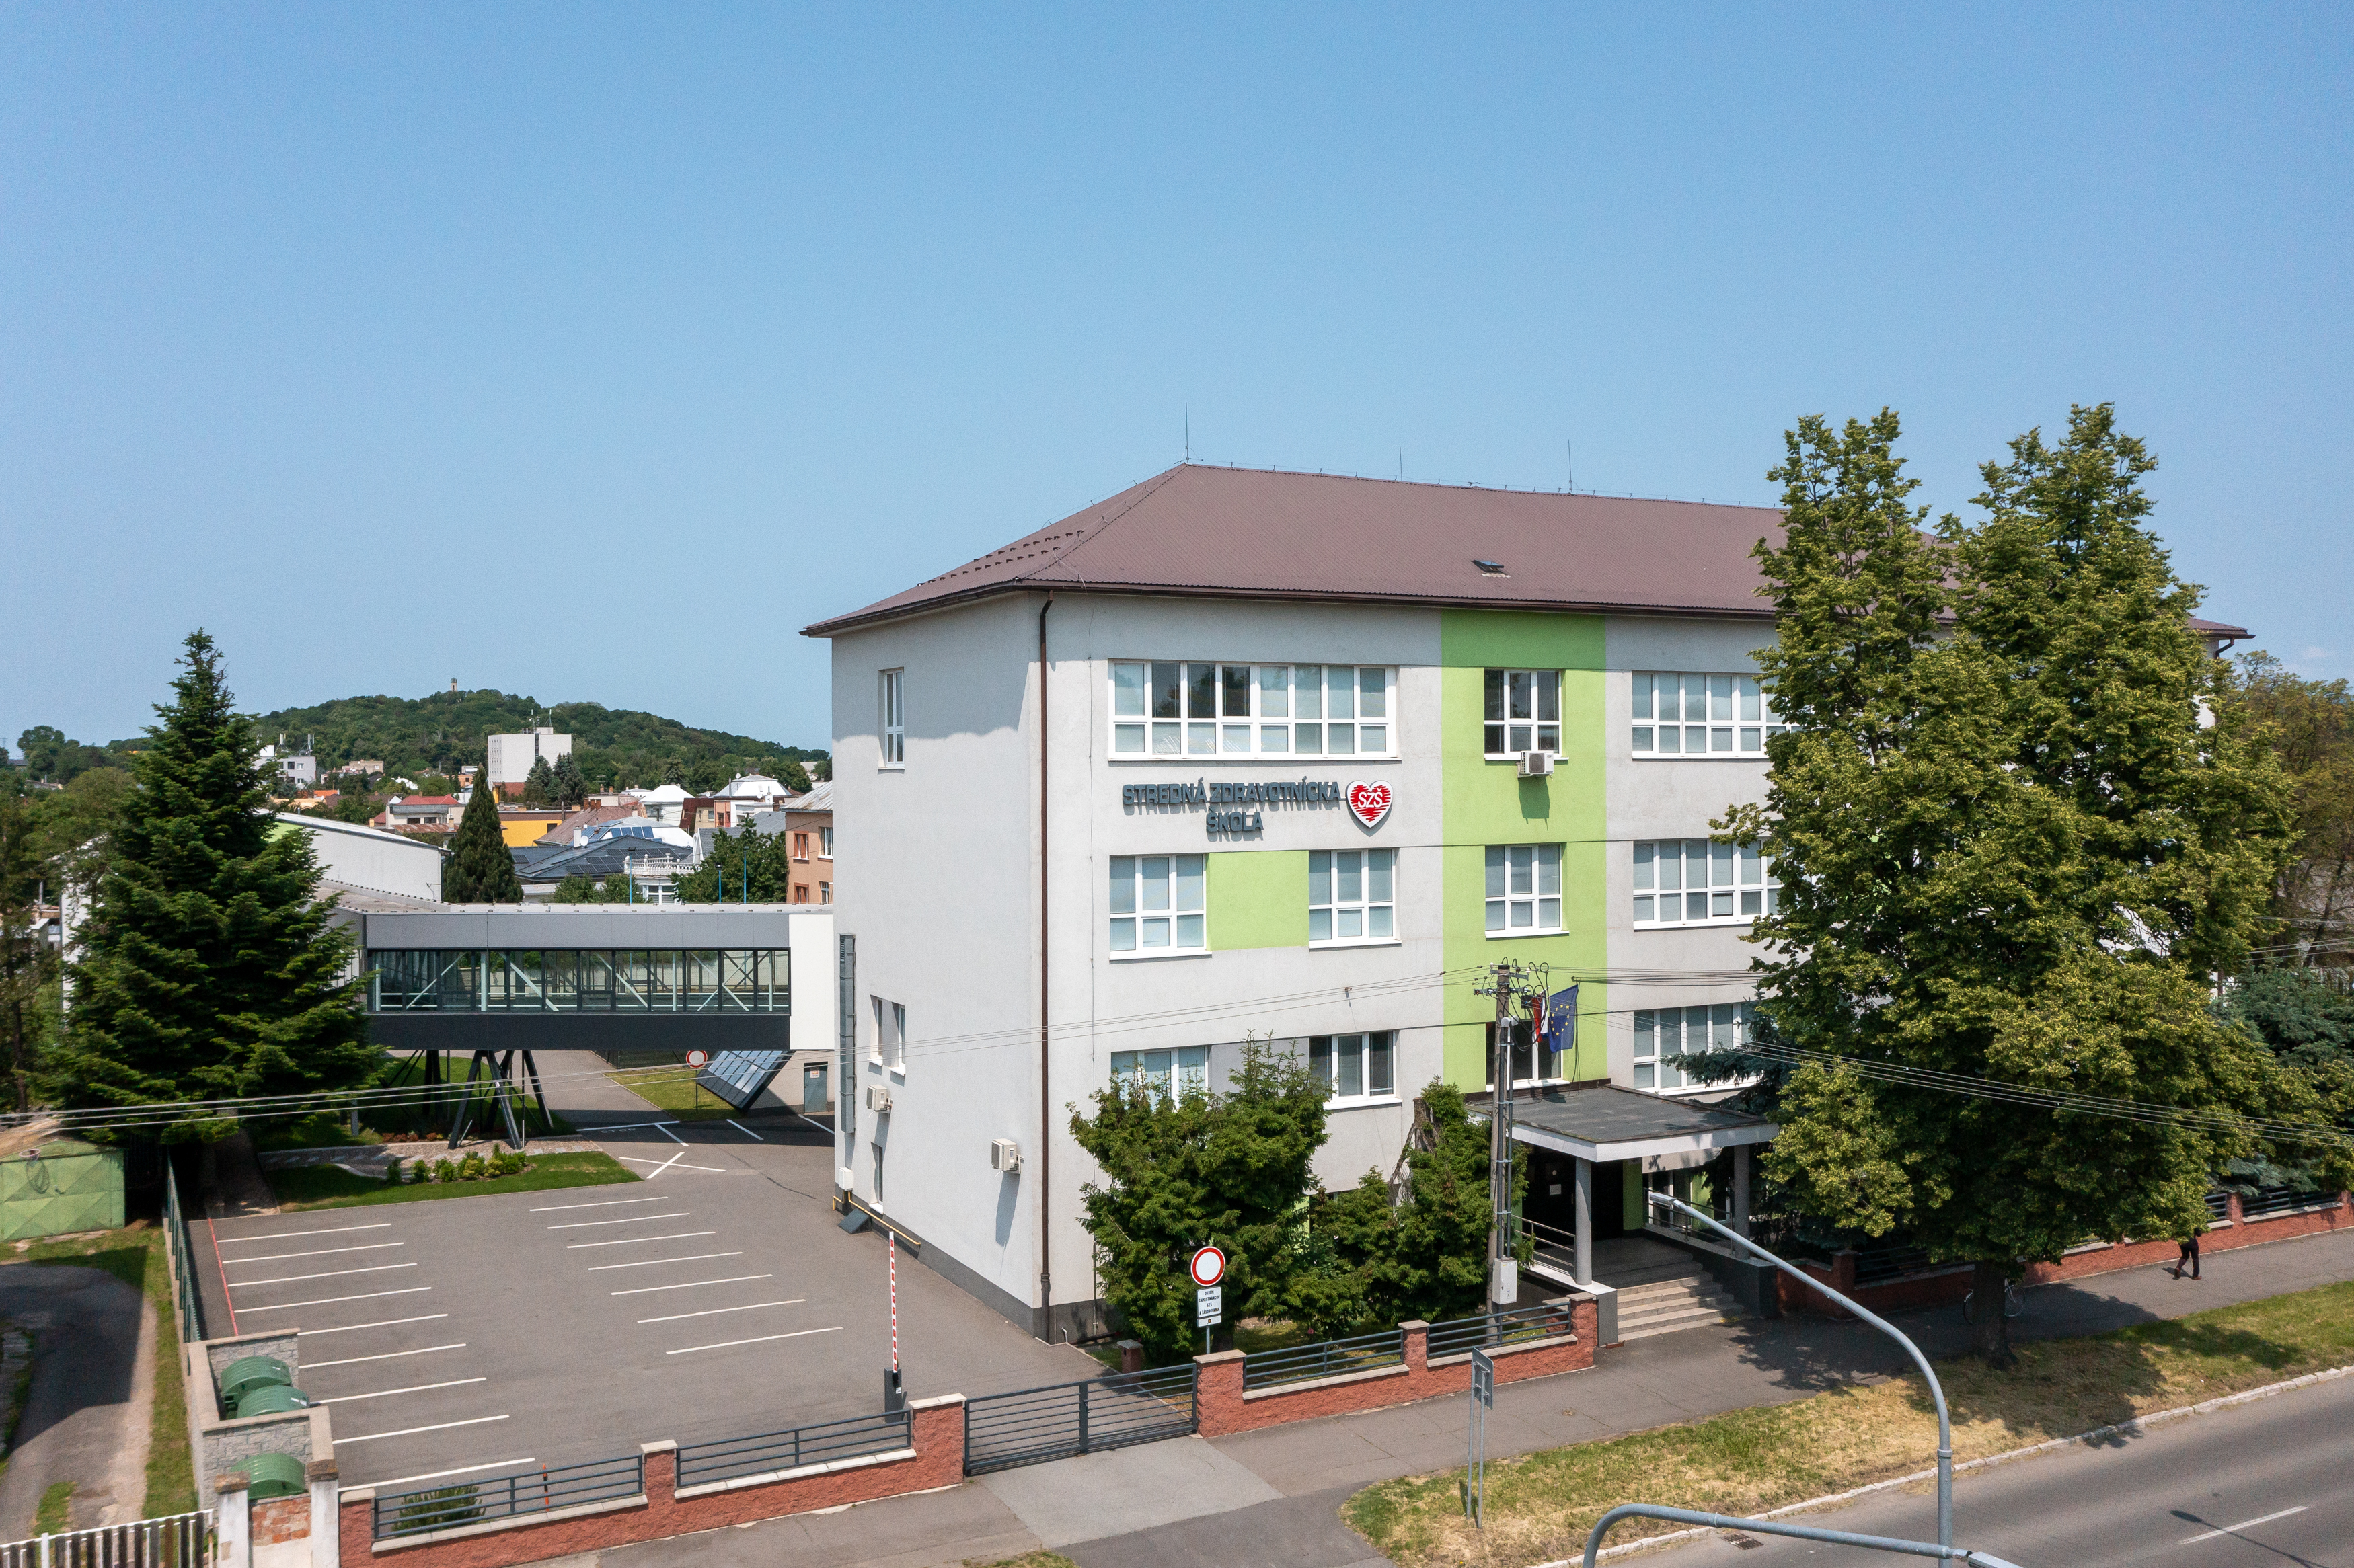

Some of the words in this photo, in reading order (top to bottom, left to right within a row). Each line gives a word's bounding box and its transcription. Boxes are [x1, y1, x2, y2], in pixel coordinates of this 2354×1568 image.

[1123, 777, 1206, 804] STREDNÁ
[1209, 776, 1340, 802] ZDRAVOTNÍCKA
[1357, 788, 1383, 808] SZŠ
[1206, 807, 1263, 832] ŠKOLA
